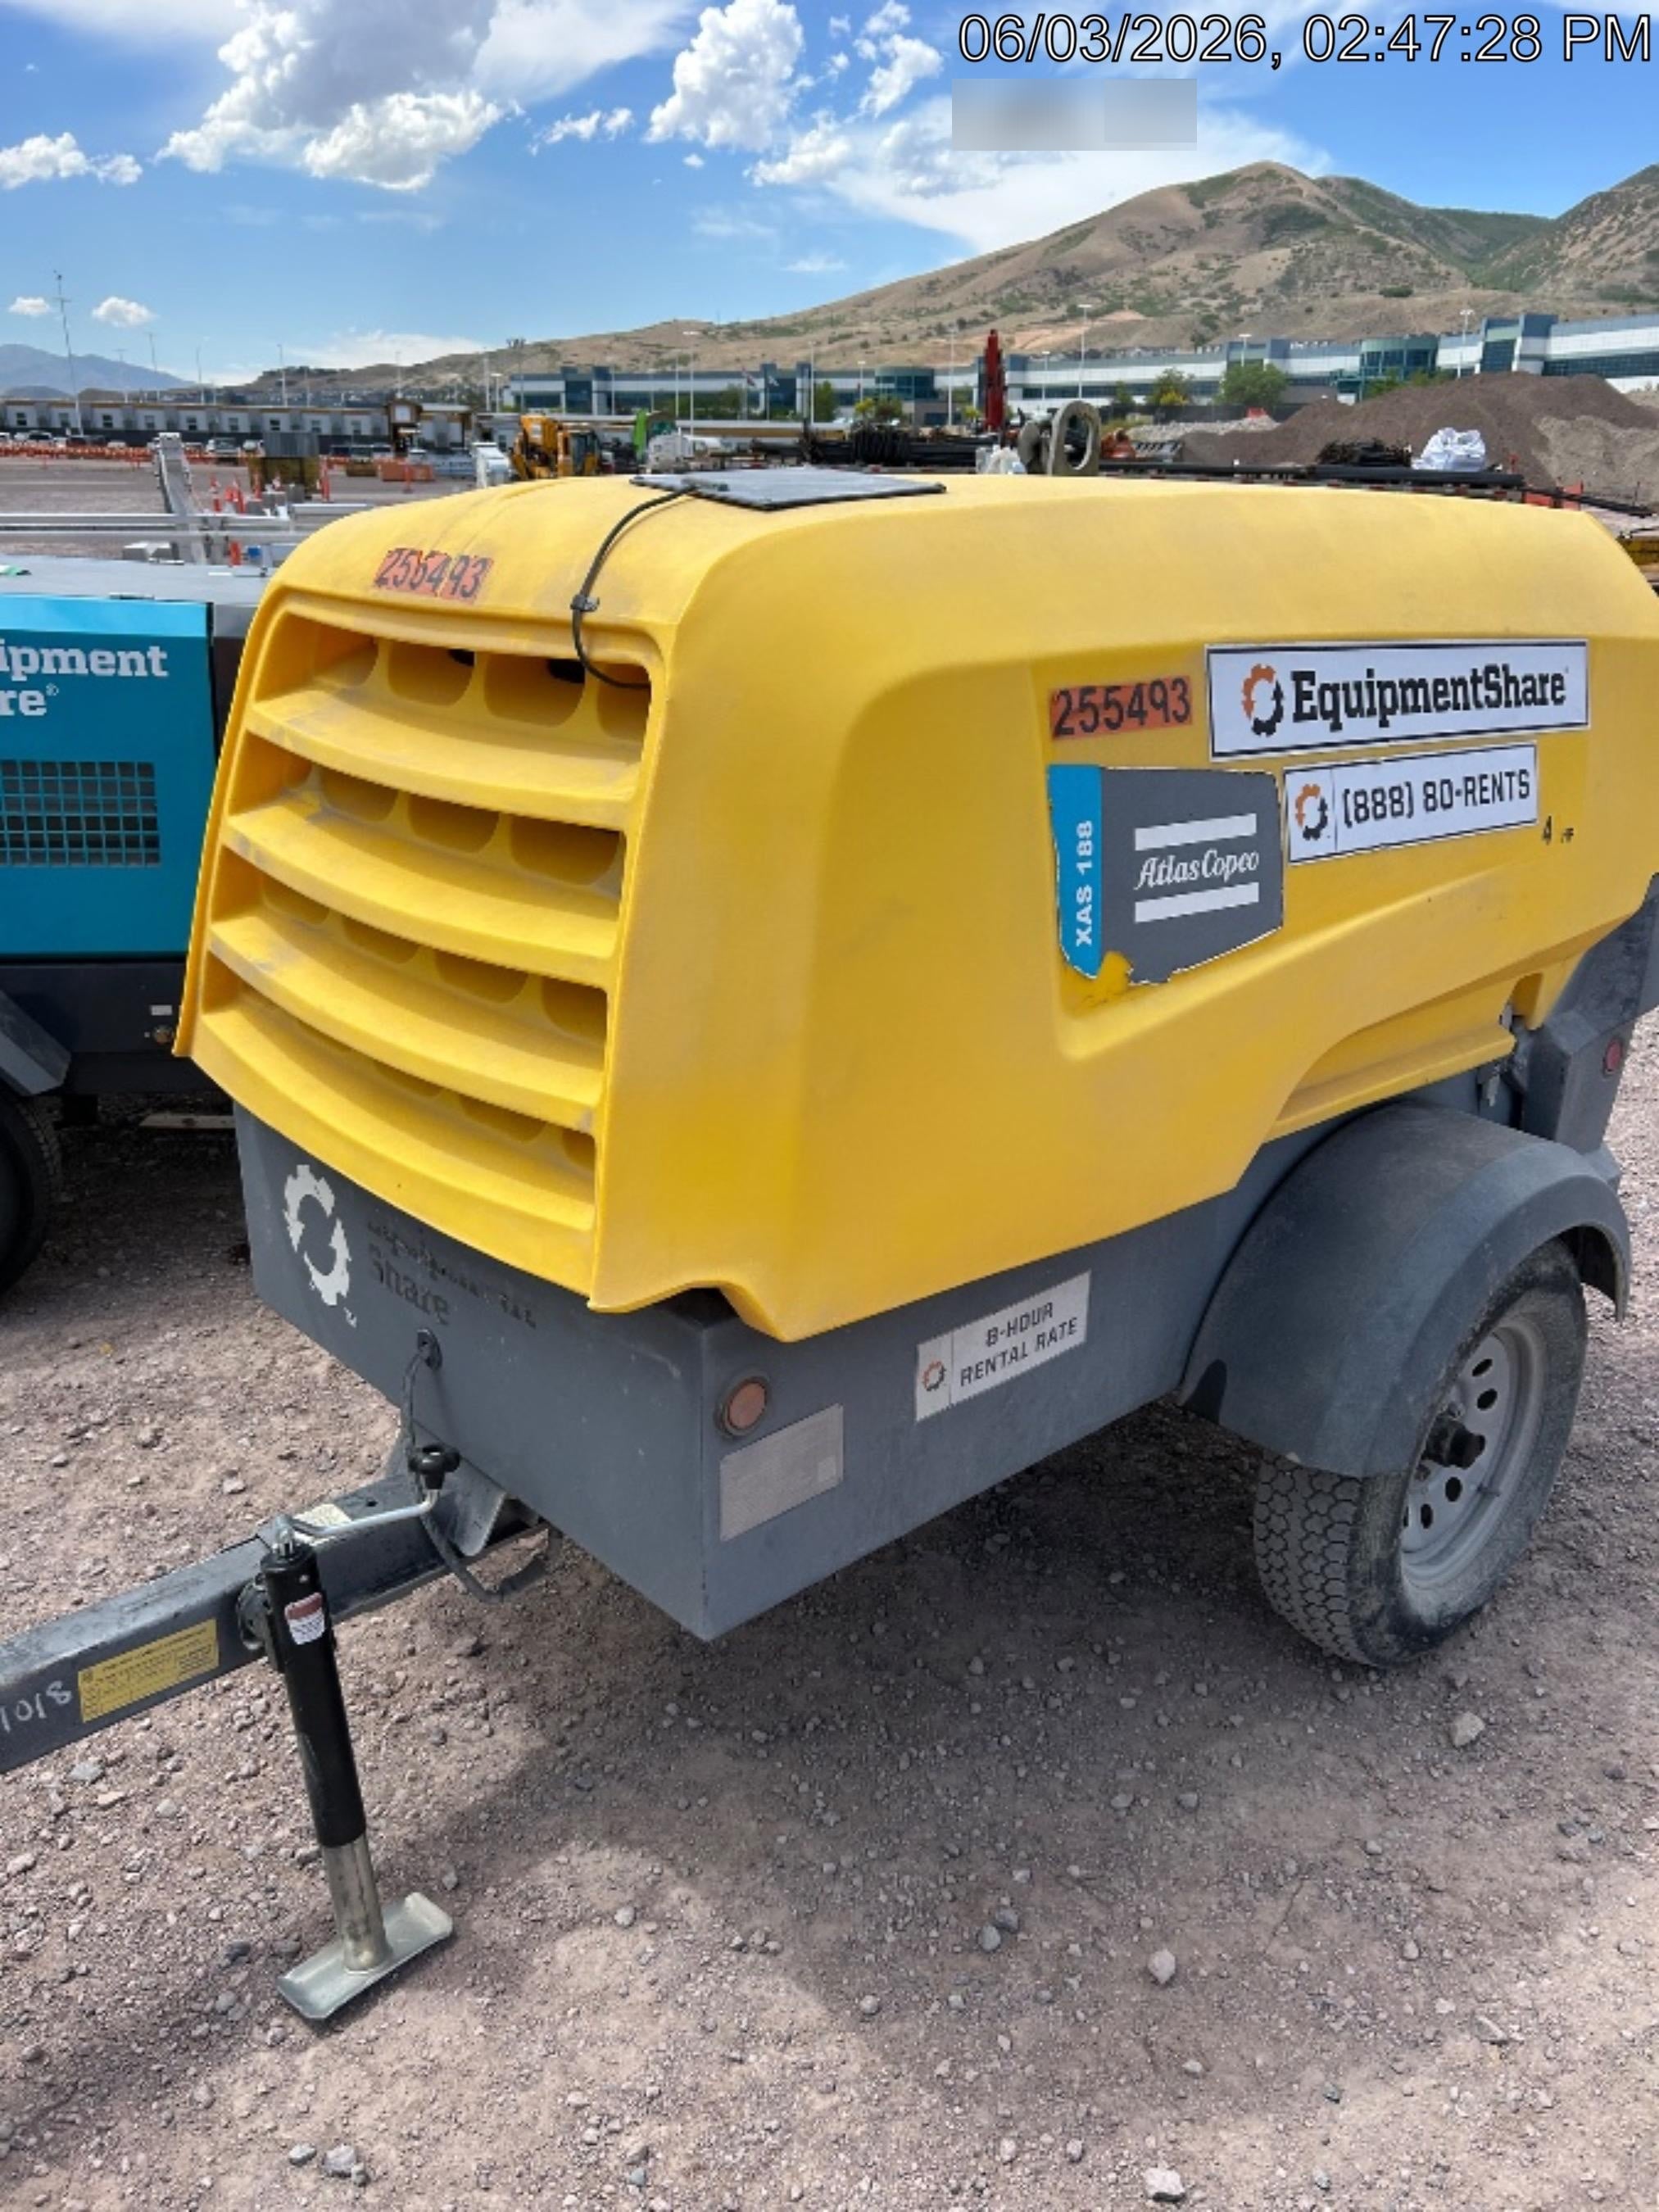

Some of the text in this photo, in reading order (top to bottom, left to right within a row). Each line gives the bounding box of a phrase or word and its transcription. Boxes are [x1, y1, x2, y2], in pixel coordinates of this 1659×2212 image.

[1053, 678, 1191, 737] 255493
[1343, 768, 1530, 828] (888) 80-RENTS
[1075, 820, 1094, 947] XAS 188
[960, 1317, 1078, 1387] RENTAL RATE
[986, 1302, 1054, 1348] 8-HOUR
